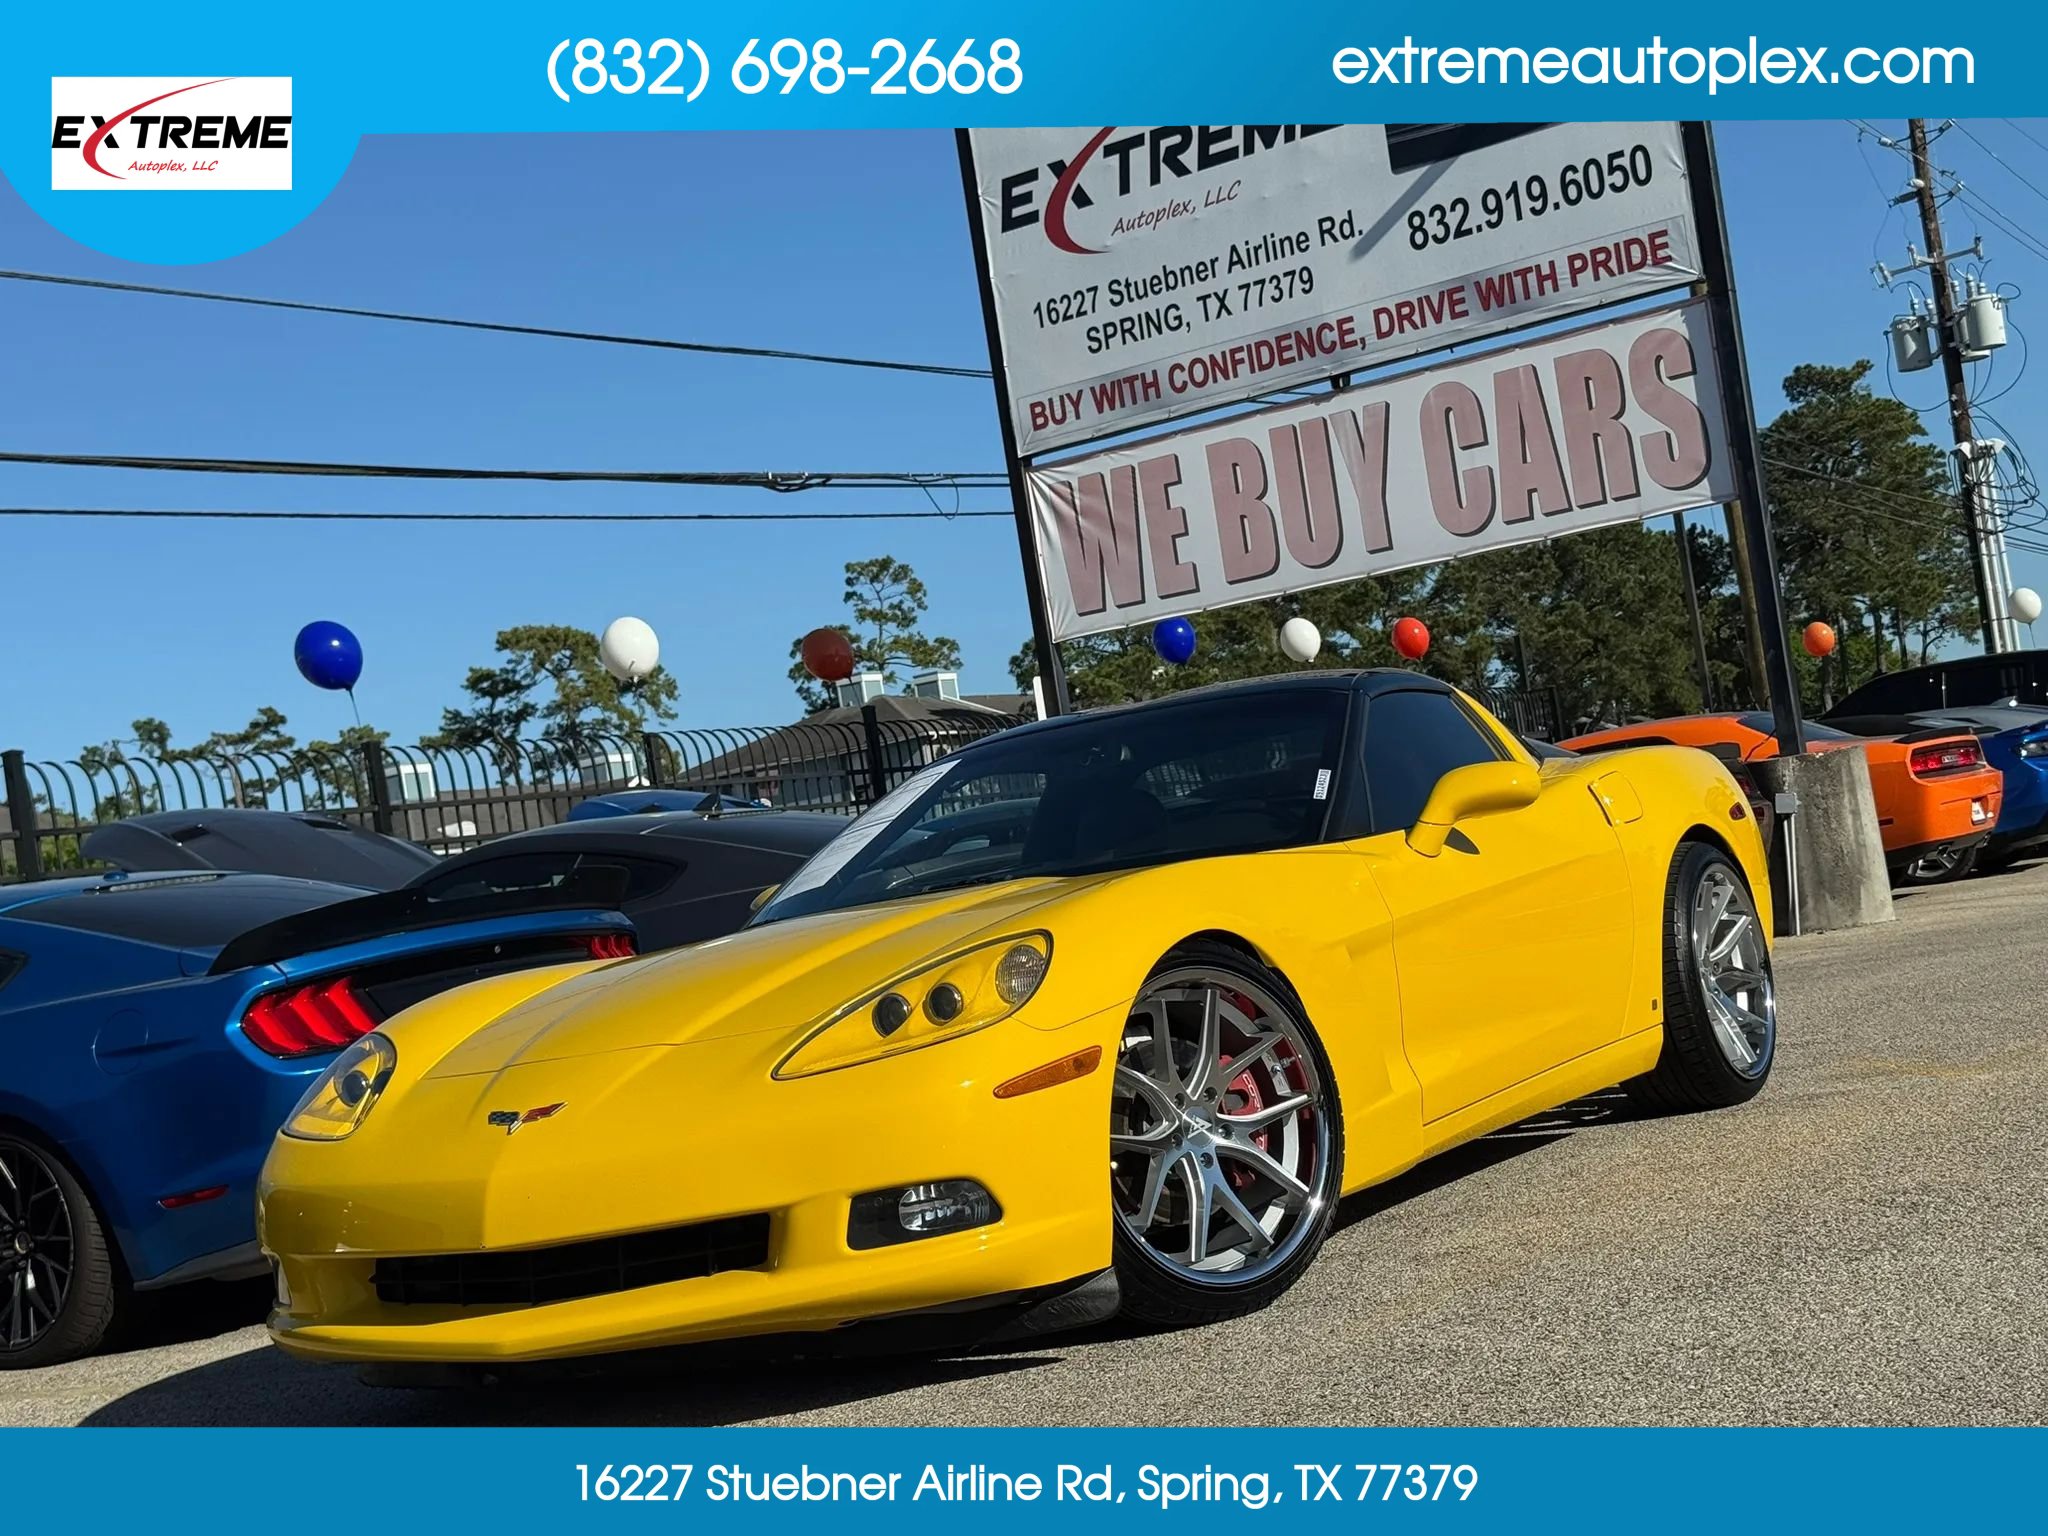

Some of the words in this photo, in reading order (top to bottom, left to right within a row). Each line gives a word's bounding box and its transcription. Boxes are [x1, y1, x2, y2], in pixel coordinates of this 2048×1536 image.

[1001, 124, 1344, 234] EXTRE
[1111, 199, 1197, 237] Autoplex,
[1203, 180, 1242, 209] LLC
[1407, 144, 1653, 251] 832.919.6050
[1033, 285, 1099, 329] 16227
[1107, 255, 1220, 308] Stuebner
[1226, 230, 1311, 275] Airline
[1317, 209, 1364, 247] Rd.
[1086, 302, 1191, 355] SPRING,
[1196, 288, 1233, 324] TX
[1238, 265, 1315, 312] 77379
[1029, 389, 1084, 432] BUY
[1090, 369, 1162, 414] WITH
[1167, 316, 1367, 395] CONFIDENCE,
[1373, 285, 1470, 340] DRIVE
[1473, 260, 1560, 312] WITH
[1567, 228, 1673, 288] PRIDE
[1050, 452, 1200, 617] WE
[1204, 400, 1394, 586] BUY
[1418, 327, 1712, 537] CARS
